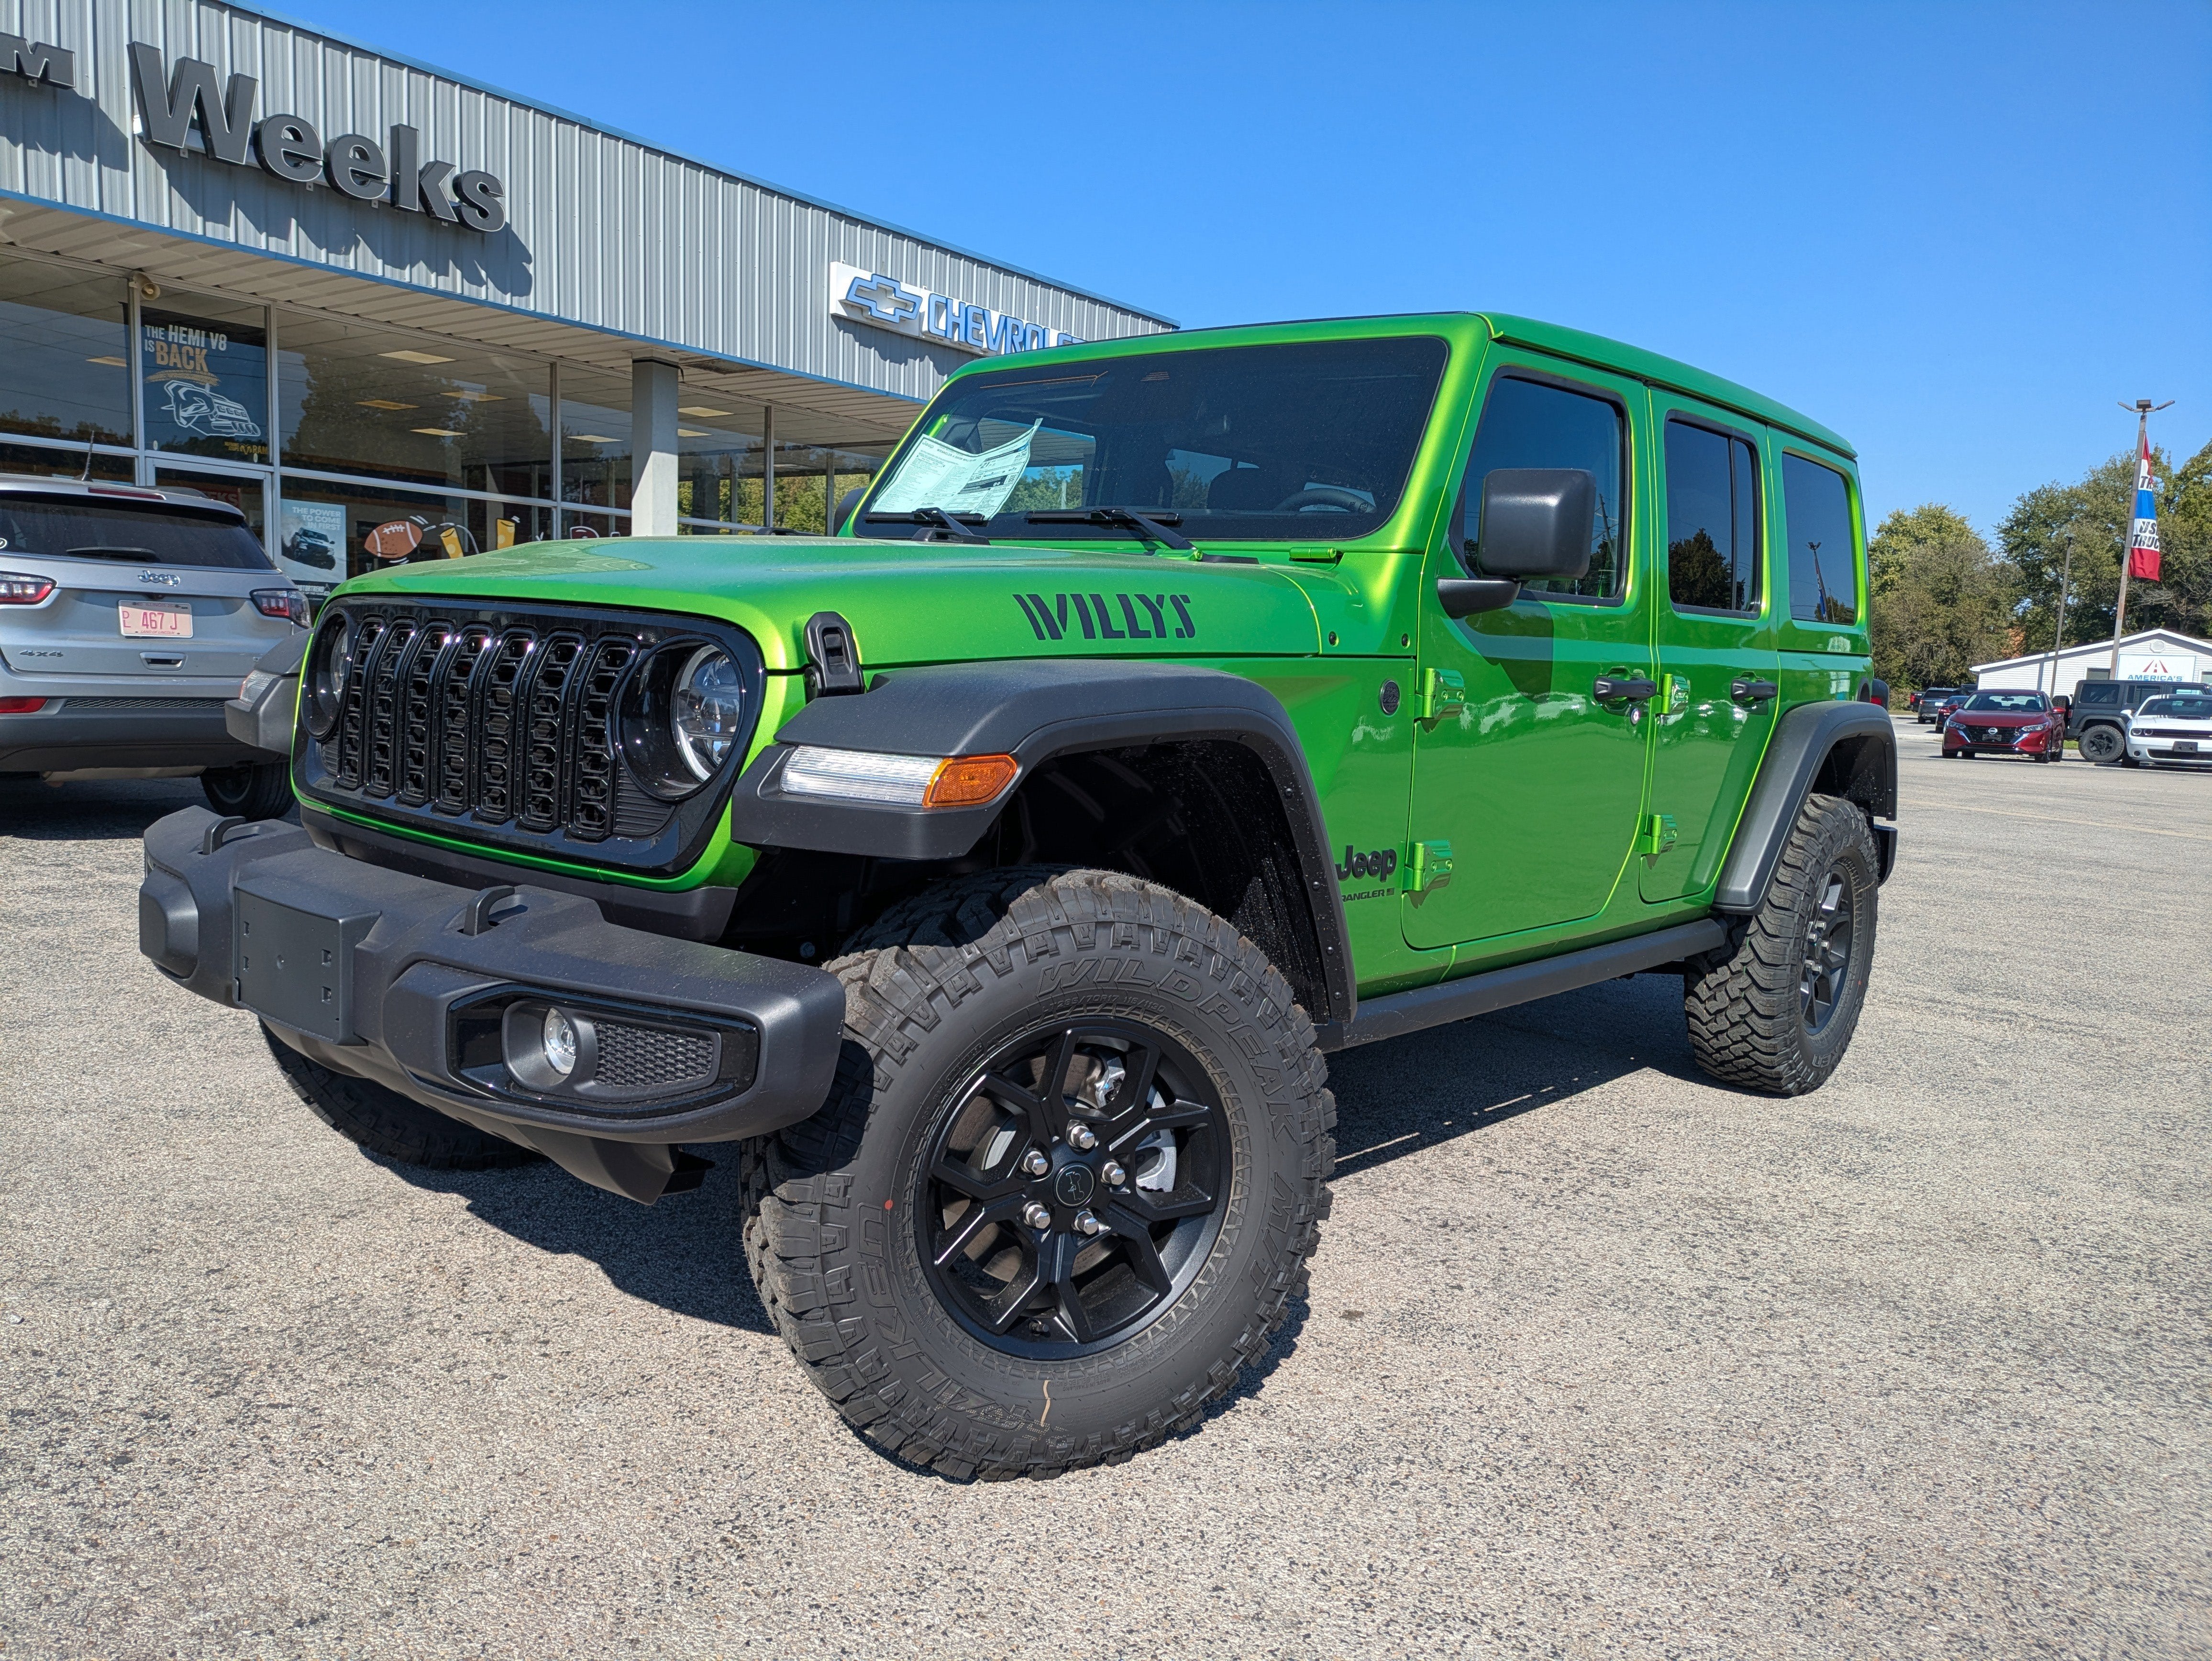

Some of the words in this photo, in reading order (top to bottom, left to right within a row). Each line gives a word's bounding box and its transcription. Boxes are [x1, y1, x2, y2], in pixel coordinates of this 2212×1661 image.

[127, 41, 505, 233] Weeks
[144, 325, 165, 340] THE
[168, 325, 205, 347] HEMI
[210, 332, 227, 351] V8
[144, 339, 155, 353] IS
[156, 341, 209, 372] BACK
[309, 508, 341, 518] POWER
[314, 516, 341, 524] COME
[138, 570, 180, 587] Jeep
[142, 612, 165, 630] 467
[170, 613, 177, 631] J
[1012, 594, 1195, 641] WILLYS
[1335, 845, 1397, 882] Jeep
[1036, 956, 1298, 1142] WILDPEAK
